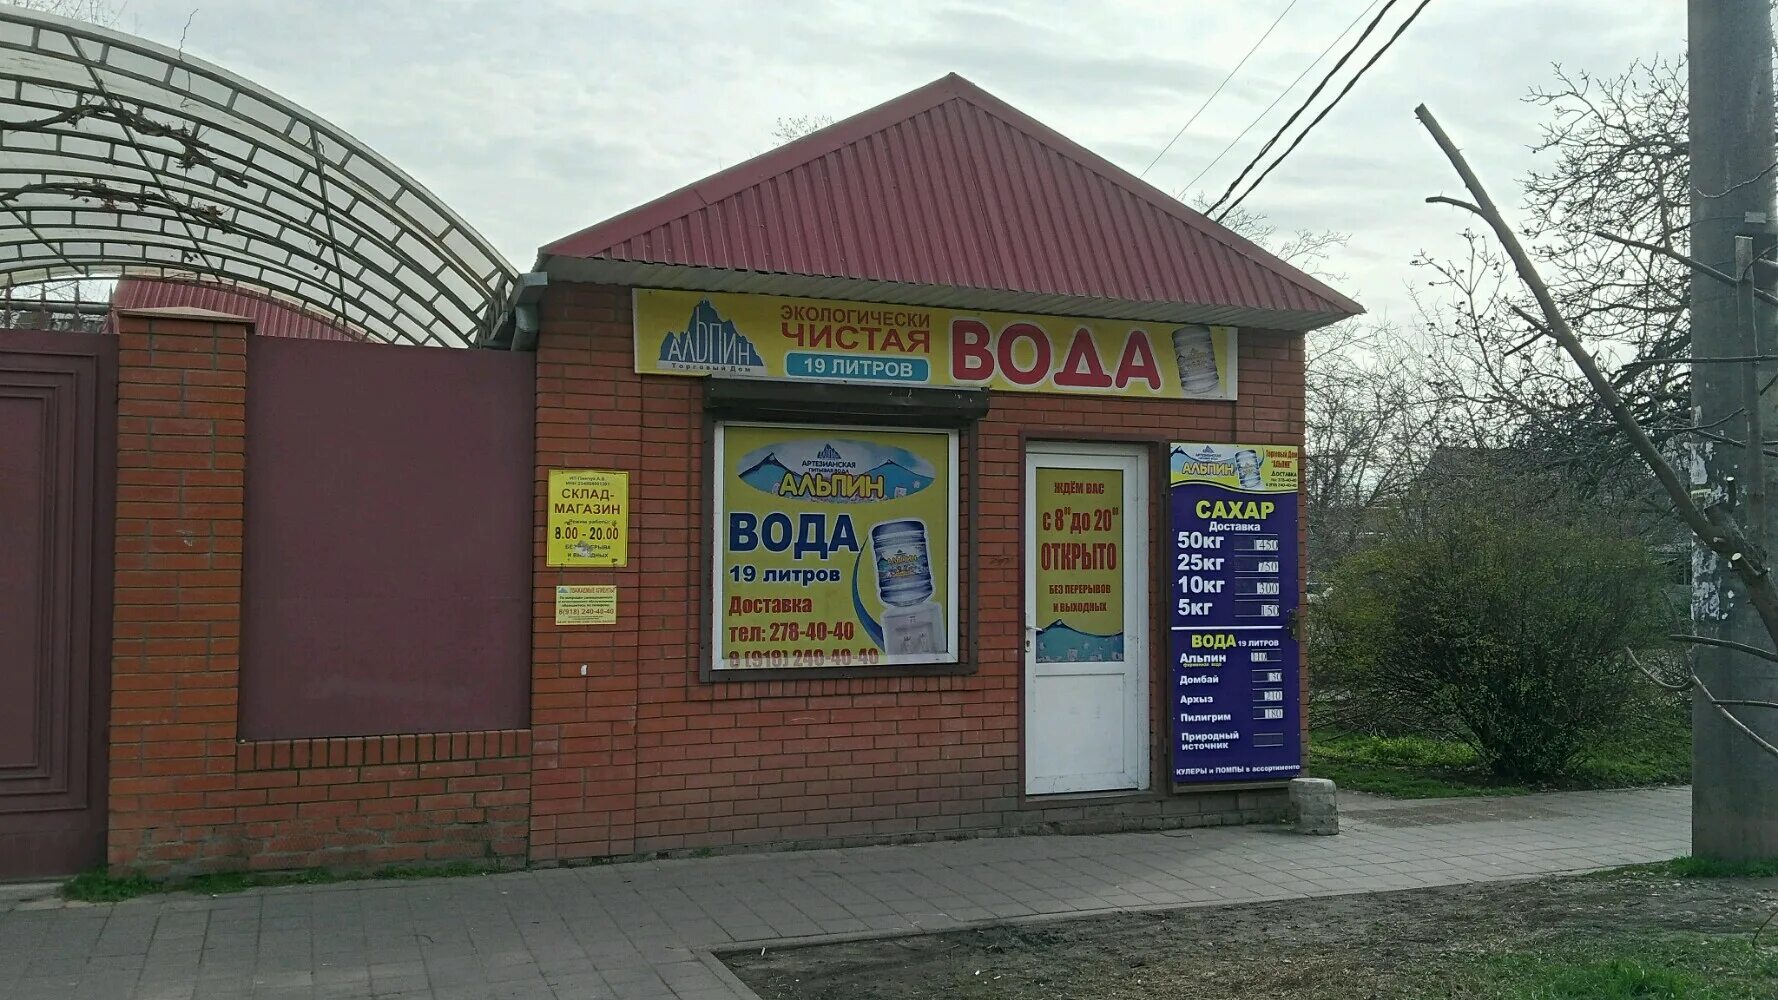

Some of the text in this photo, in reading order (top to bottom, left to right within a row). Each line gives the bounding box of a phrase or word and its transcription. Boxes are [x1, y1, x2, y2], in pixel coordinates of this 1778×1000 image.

[780, 304, 930, 328] ЭКОЛОГИЧЕСКИ
[668, 306, 750, 365] АЛЬПИН
[781, 322, 930, 353] ЧИСТАЯ
[952, 319, 1162, 390] ВОДА
[672, 361, 752, 373] Торговый Дом
[804, 356, 914, 378] 19 ЛИТРОВ
[801, 459, 856, 469] АРТЕЗИАНСКАЯ
[1182, 461, 1235, 476] АЛЬПИН
[777, 470, 885, 499] АЛЬПИН
[1054, 480, 1105, 496] ЖДЁМ ВАС
[561, 488, 615, 502] СКЛАД-
[554, 503, 621, 515] МАГАЗИН
[1195, 500, 1275, 519] САХАР
[1070, 512, 1091, 534] до
[1208, 521, 1261, 532] Доставка
[554, 526, 578, 540] 8.00
[589, 526, 619, 541] 20.00
[729, 512, 860, 559] ВОДА
[1177, 532, 1225, 549] 50кг
[1040, 542, 1117, 571] ОТКРЫТО
[1177, 553, 1225, 571] 25кг
[729, 566, 841, 586] 19 литров
[1049, 583, 1112, 595] БЕЗ ПЕРЕРЫВОВ
[1178, 576, 1225, 593] 10кг
[728, 596, 813, 616] Доставка
[1060, 601, 1107, 614] ВЫХОДНЫХ
[1177, 598, 1213, 616] 5кг
[728, 621, 855, 643] тел: 278-40-40
[1191, 634, 1237, 649] ВОДА
[793, 648, 880, 667] 240-40-40
[1180, 653, 1226, 663] Альпин
[1180, 675, 1219, 686] Домбай
[1180, 695, 1213, 705] Архыз
[1180, 712, 1232, 723] Пилигрим
[1181, 731, 1240, 743] Природный
[1181, 741, 1229, 751] источник
[1176, 767, 1208, 776] КУЛЕРЫ
[1215, 766, 1244, 774] ПОМПЫ
